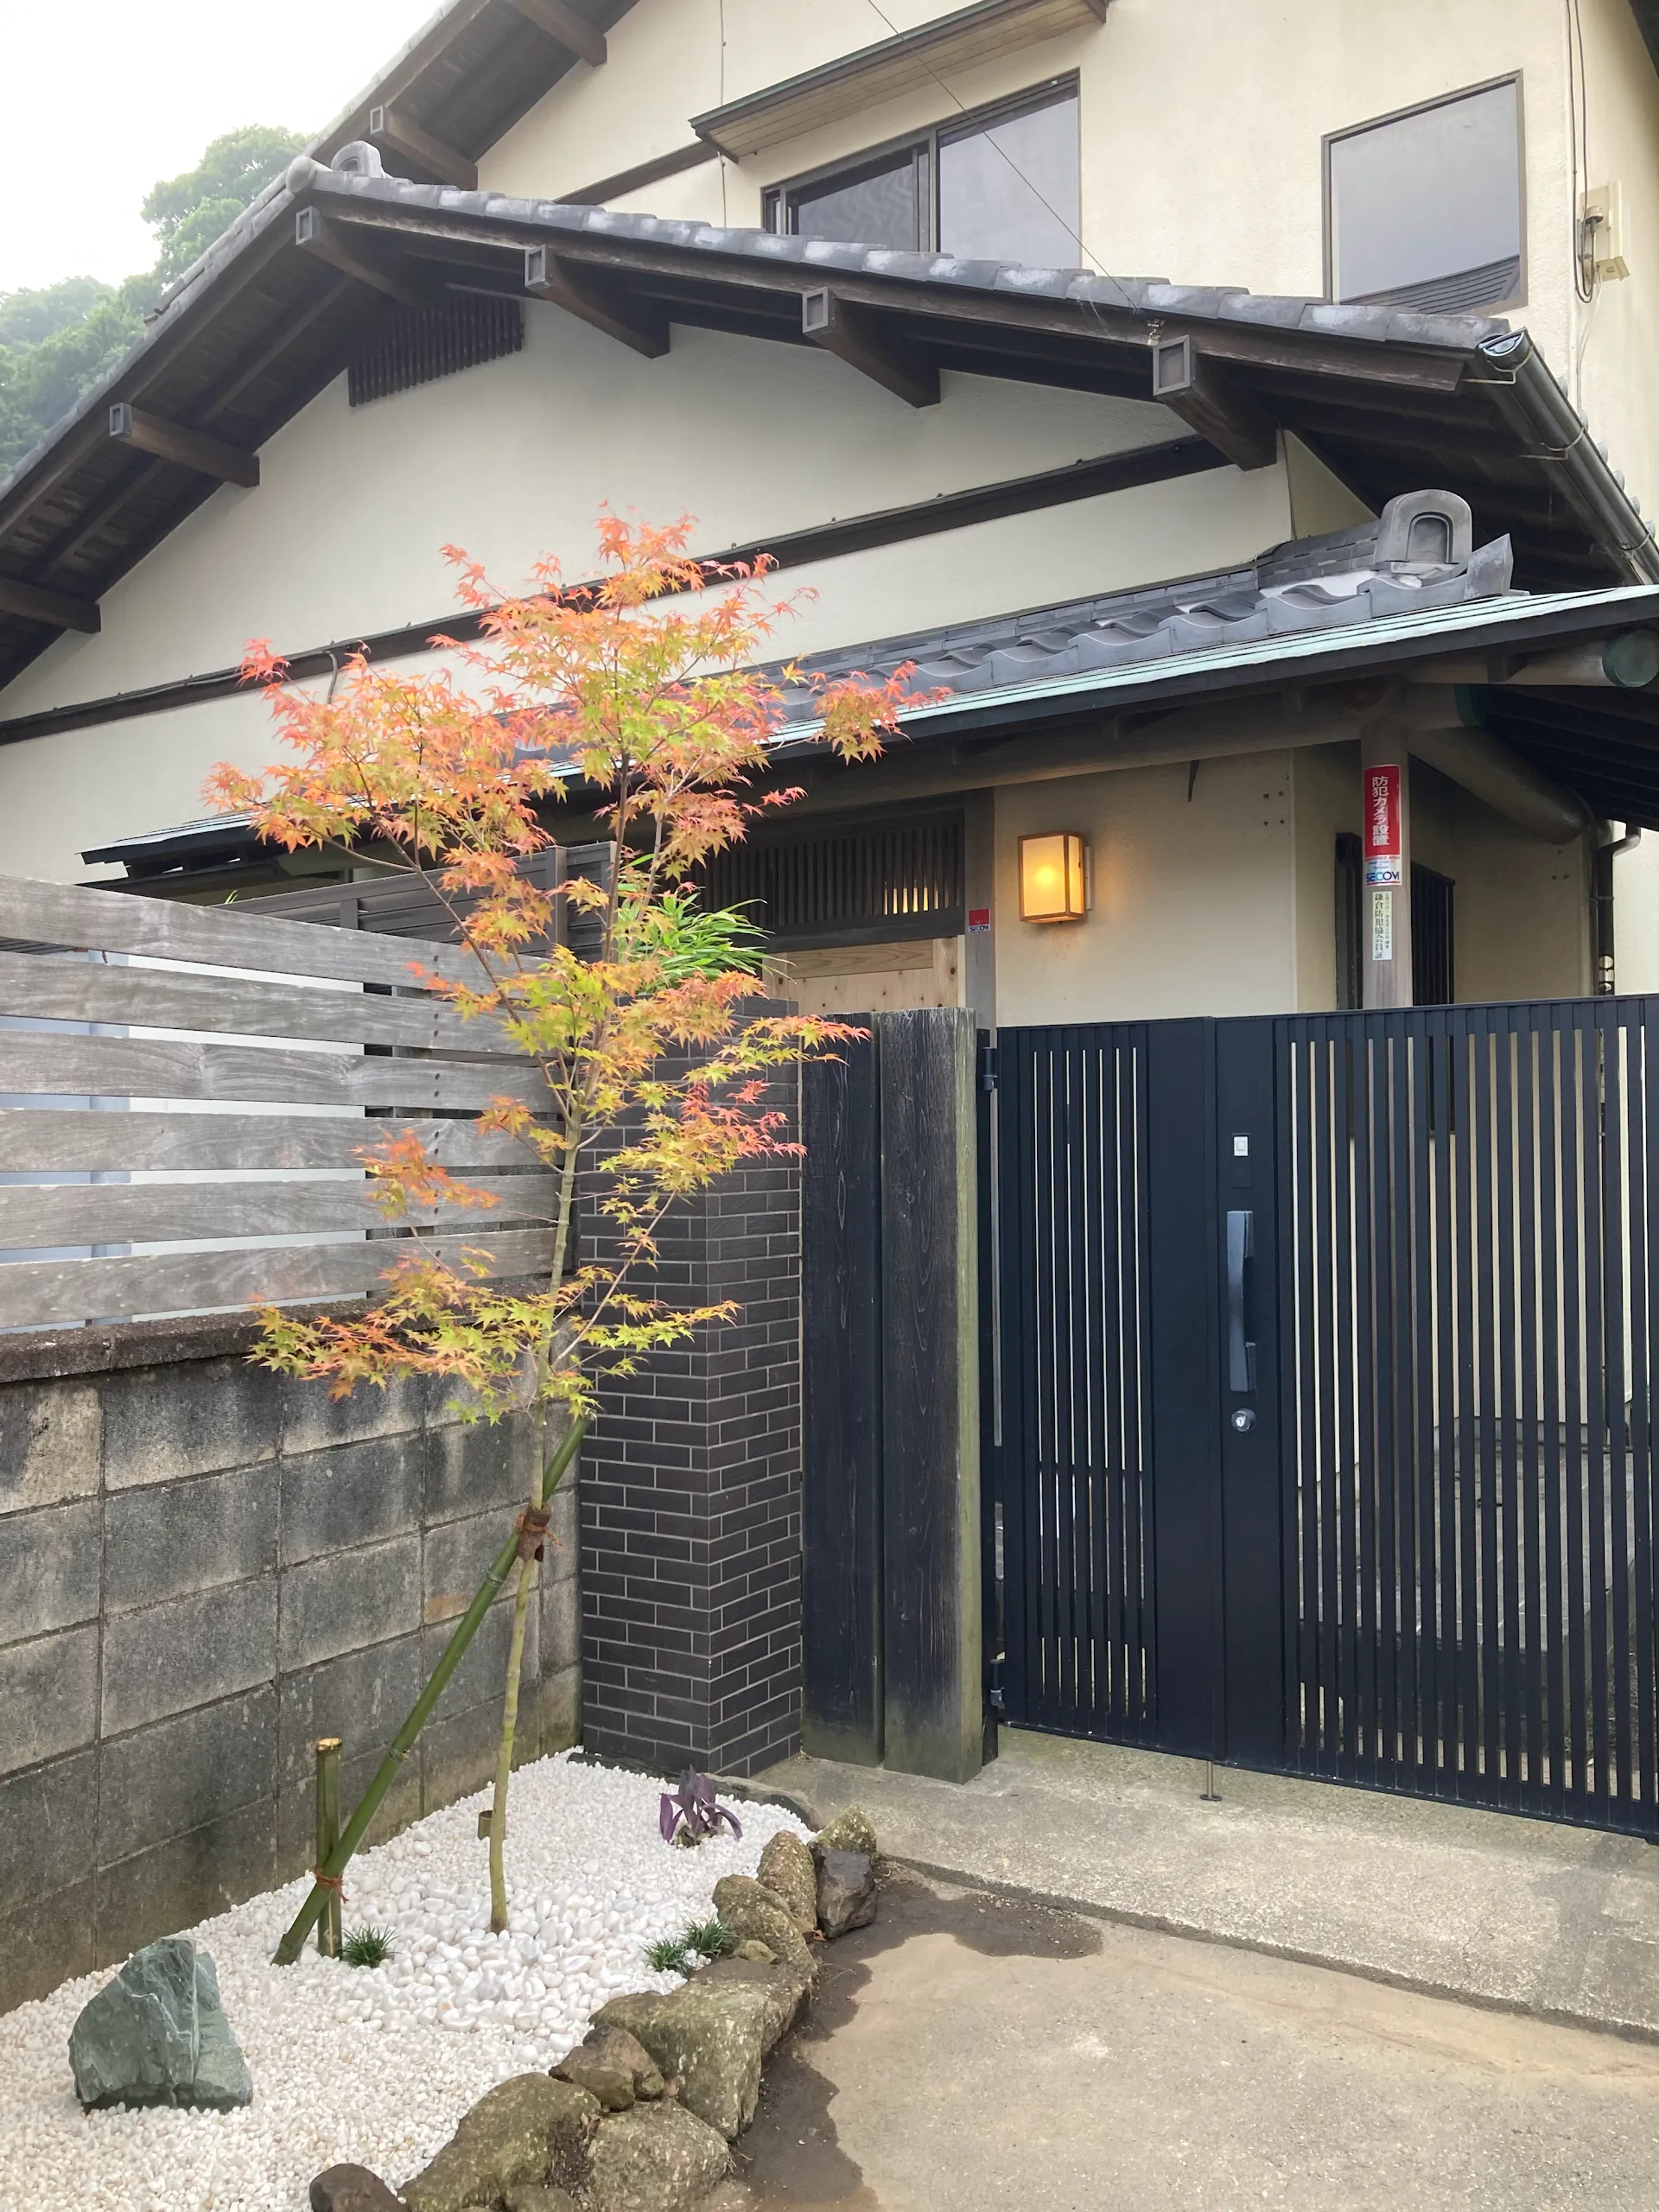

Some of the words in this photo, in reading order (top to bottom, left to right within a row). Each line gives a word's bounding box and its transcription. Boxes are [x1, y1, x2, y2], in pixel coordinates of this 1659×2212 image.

[1372, 776, 1389, 846] 防犯カメラ設置
[1366, 871, 1400, 882] SECOM
